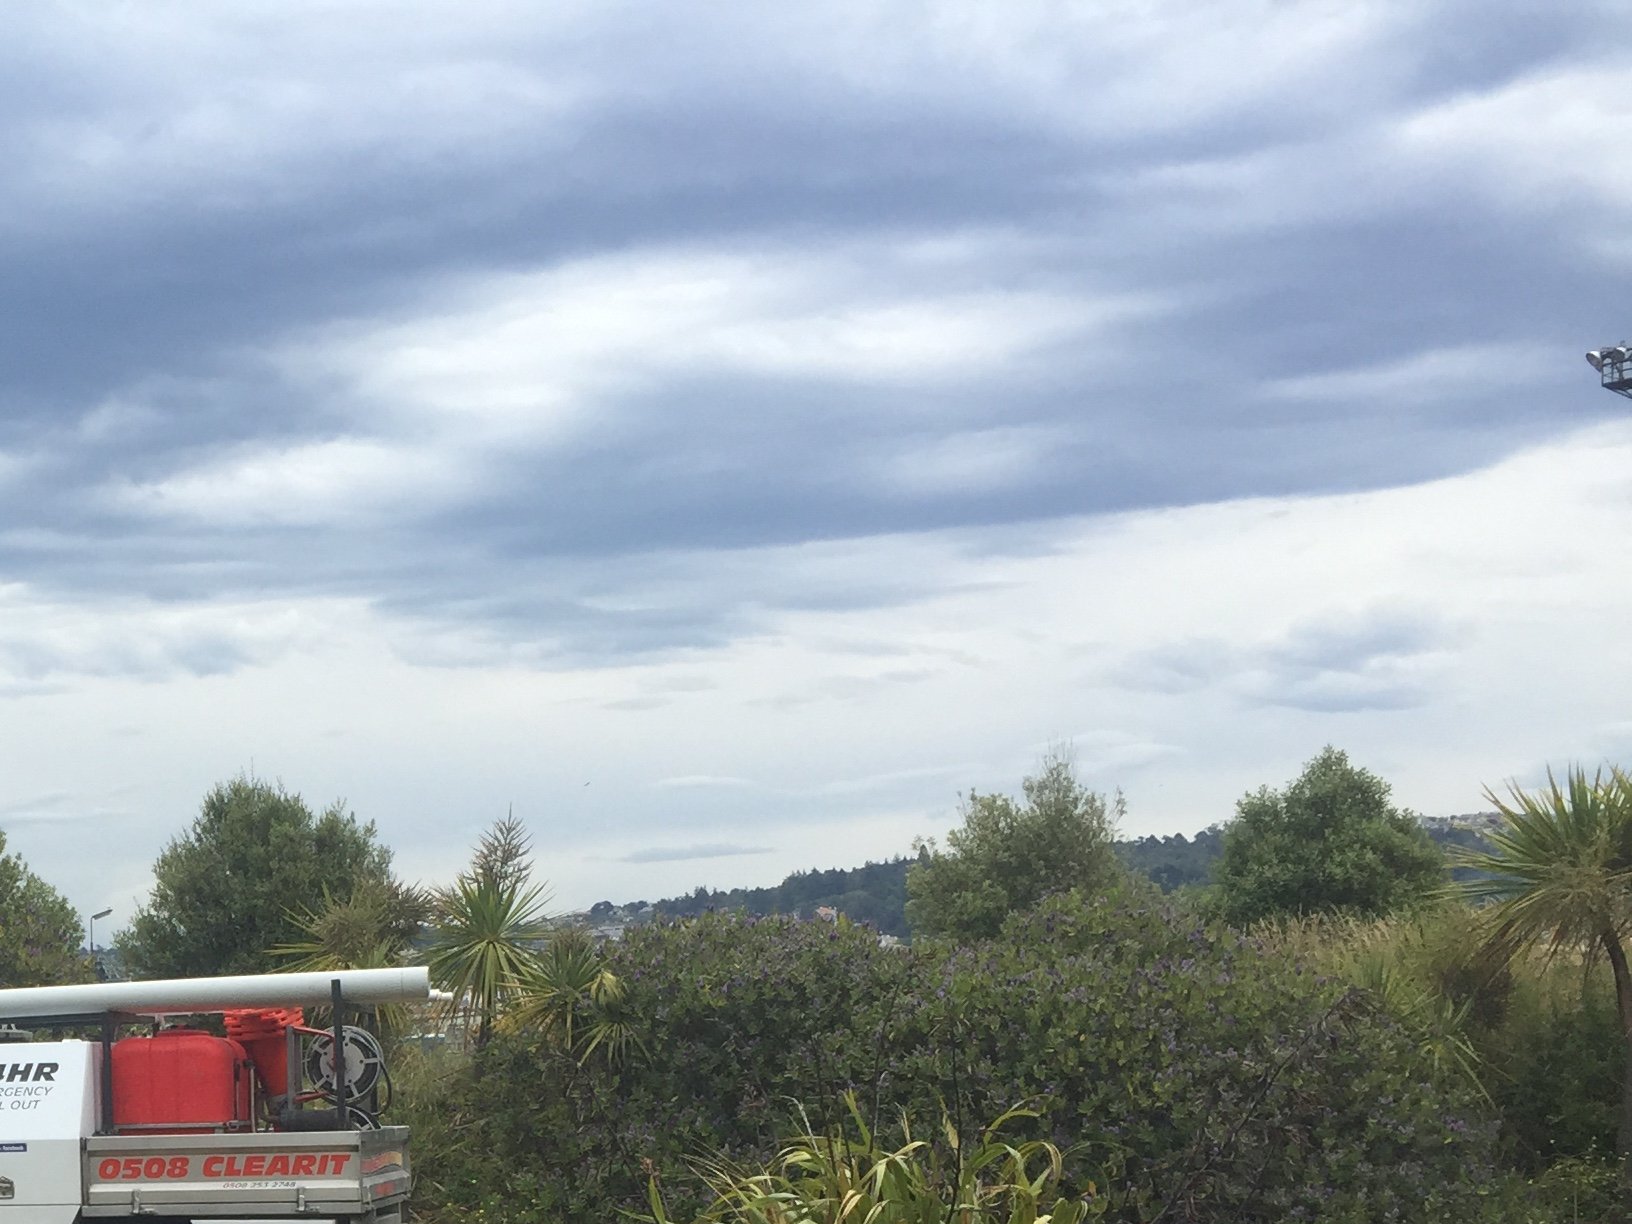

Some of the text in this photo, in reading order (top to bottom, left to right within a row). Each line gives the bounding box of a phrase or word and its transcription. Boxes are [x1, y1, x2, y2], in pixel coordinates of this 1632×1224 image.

[10, 1100, 41, 1110] OUT
[98, 1156, 190, 1180] 0508
[202, 1154, 351, 1177] CLEARIT
